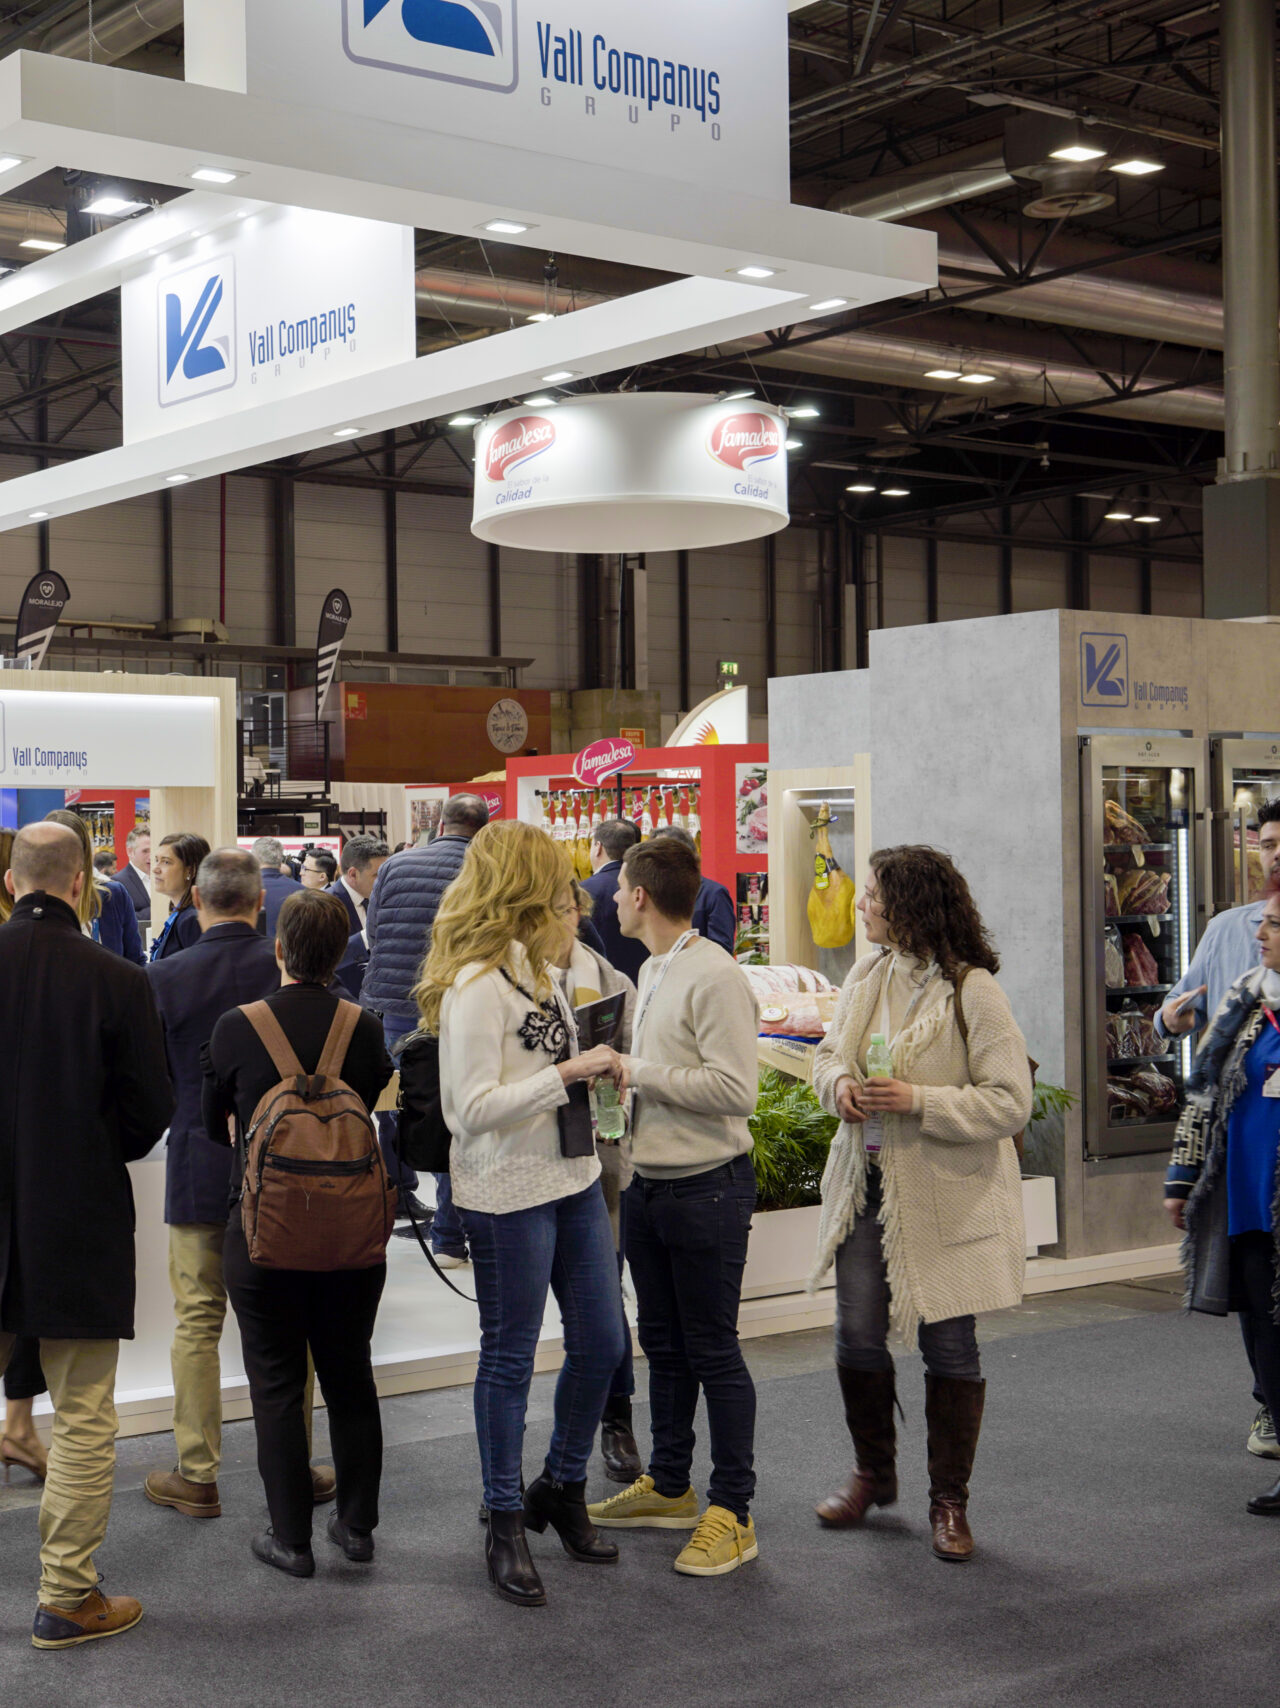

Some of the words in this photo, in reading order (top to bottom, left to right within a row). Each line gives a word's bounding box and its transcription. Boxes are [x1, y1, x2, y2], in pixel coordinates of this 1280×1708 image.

[536, 21, 583, 86] Vall
[592, 34, 720, 122] Companys
[540, 87, 721, 141] GRUPO
[248, 325, 275, 367] Vall
[278, 302, 356, 357] Companys
[486, 422, 553, 475] famadesa
[714, 417, 779, 456] famadesa
[495, 486, 533, 505] Calidad
[733, 482, 769, 500] Calidad
[28, 598, 64, 607] MORALEJO
[1133, 681, 1148, 701] Vall
[1149, 681, 1188, 705] Companys
[12, 747, 32, 766] Vall
[34, 747, 88, 770] Companys
[578, 741, 633, 778] famadesa
